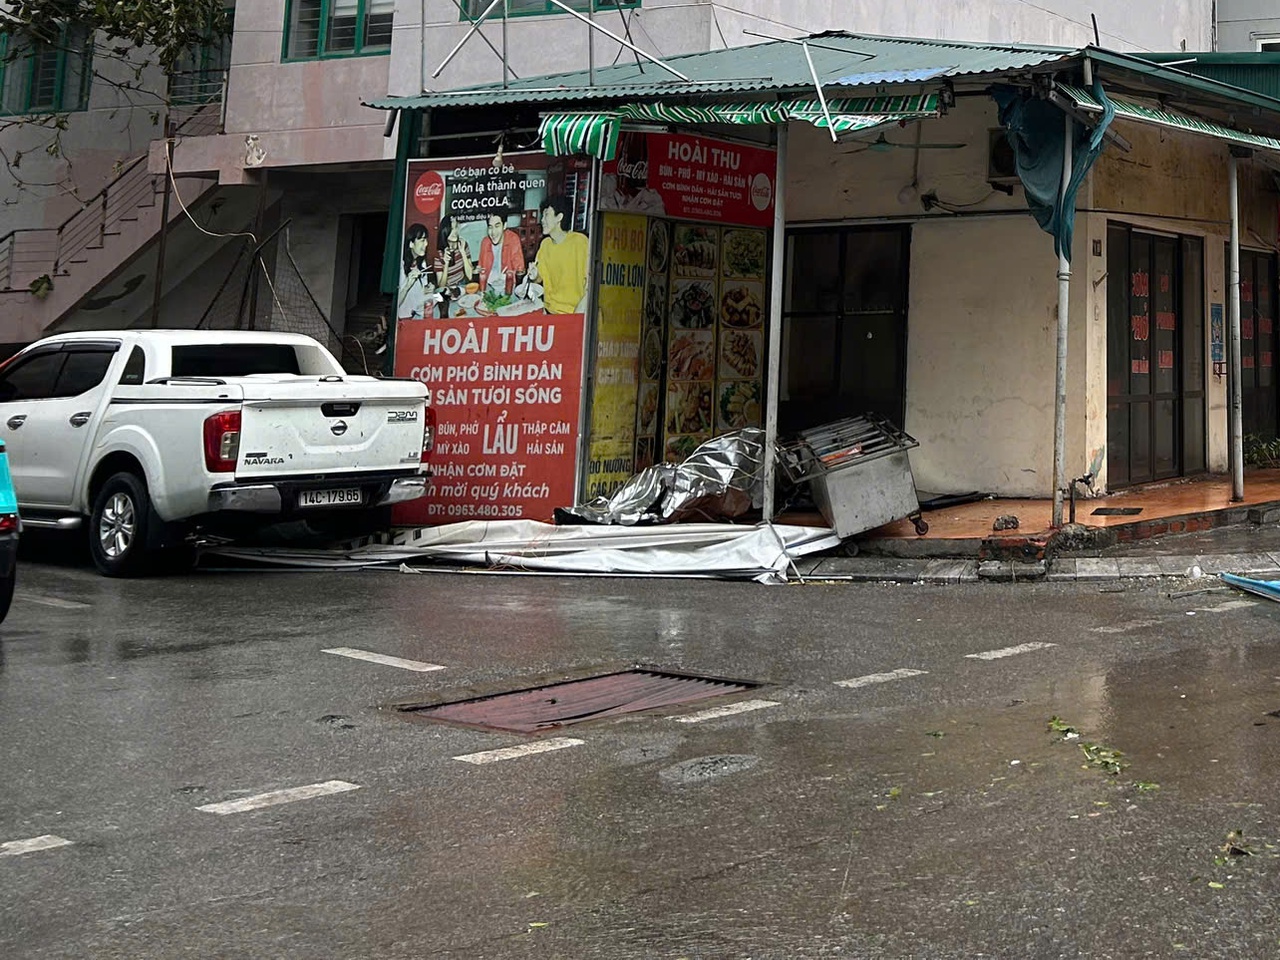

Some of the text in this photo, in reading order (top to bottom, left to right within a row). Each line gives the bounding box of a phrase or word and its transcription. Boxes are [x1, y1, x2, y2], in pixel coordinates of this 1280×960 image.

[668, 139, 741, 170] HOÀI THU
[454, 166, 467, 178] Có
[468, 166, 487, 179] bạn
[502, 163, 514, 174] bè
[452, 178, 546, 194] Món lạ thành quen
[600, 257, 644, 292] LÒNG LỢN
[423, 322, 555, 355] HOÀI THU
[411, 361, 562, 382] CƠM PHỞ BÌNH DÂN
[436, 385, 468, 405] SẢN
[472, 386, 510, 405] TƯƠI
[514, 382, 562, 404] SỐNG
[438, 420, 479, 436] BÚN, PHỞ
[483, 410, 518, 454] LẨU
[522, 422, 547, 437] THẬP
[452, 441, 469, 454] XÀO
[526, 440, 564, 454] HẢI SẢN
[244, 457, 285, 466] NAVARA
[429, 461, 526, 478] NHẬN CƠM ĐẶT
[441, 482, 466, 497] mời
[470, 483, 500, 500] quý
[503, 482, 550, 498] khách
[428, 504, 523, 517] ĐT: 0963.480.305
